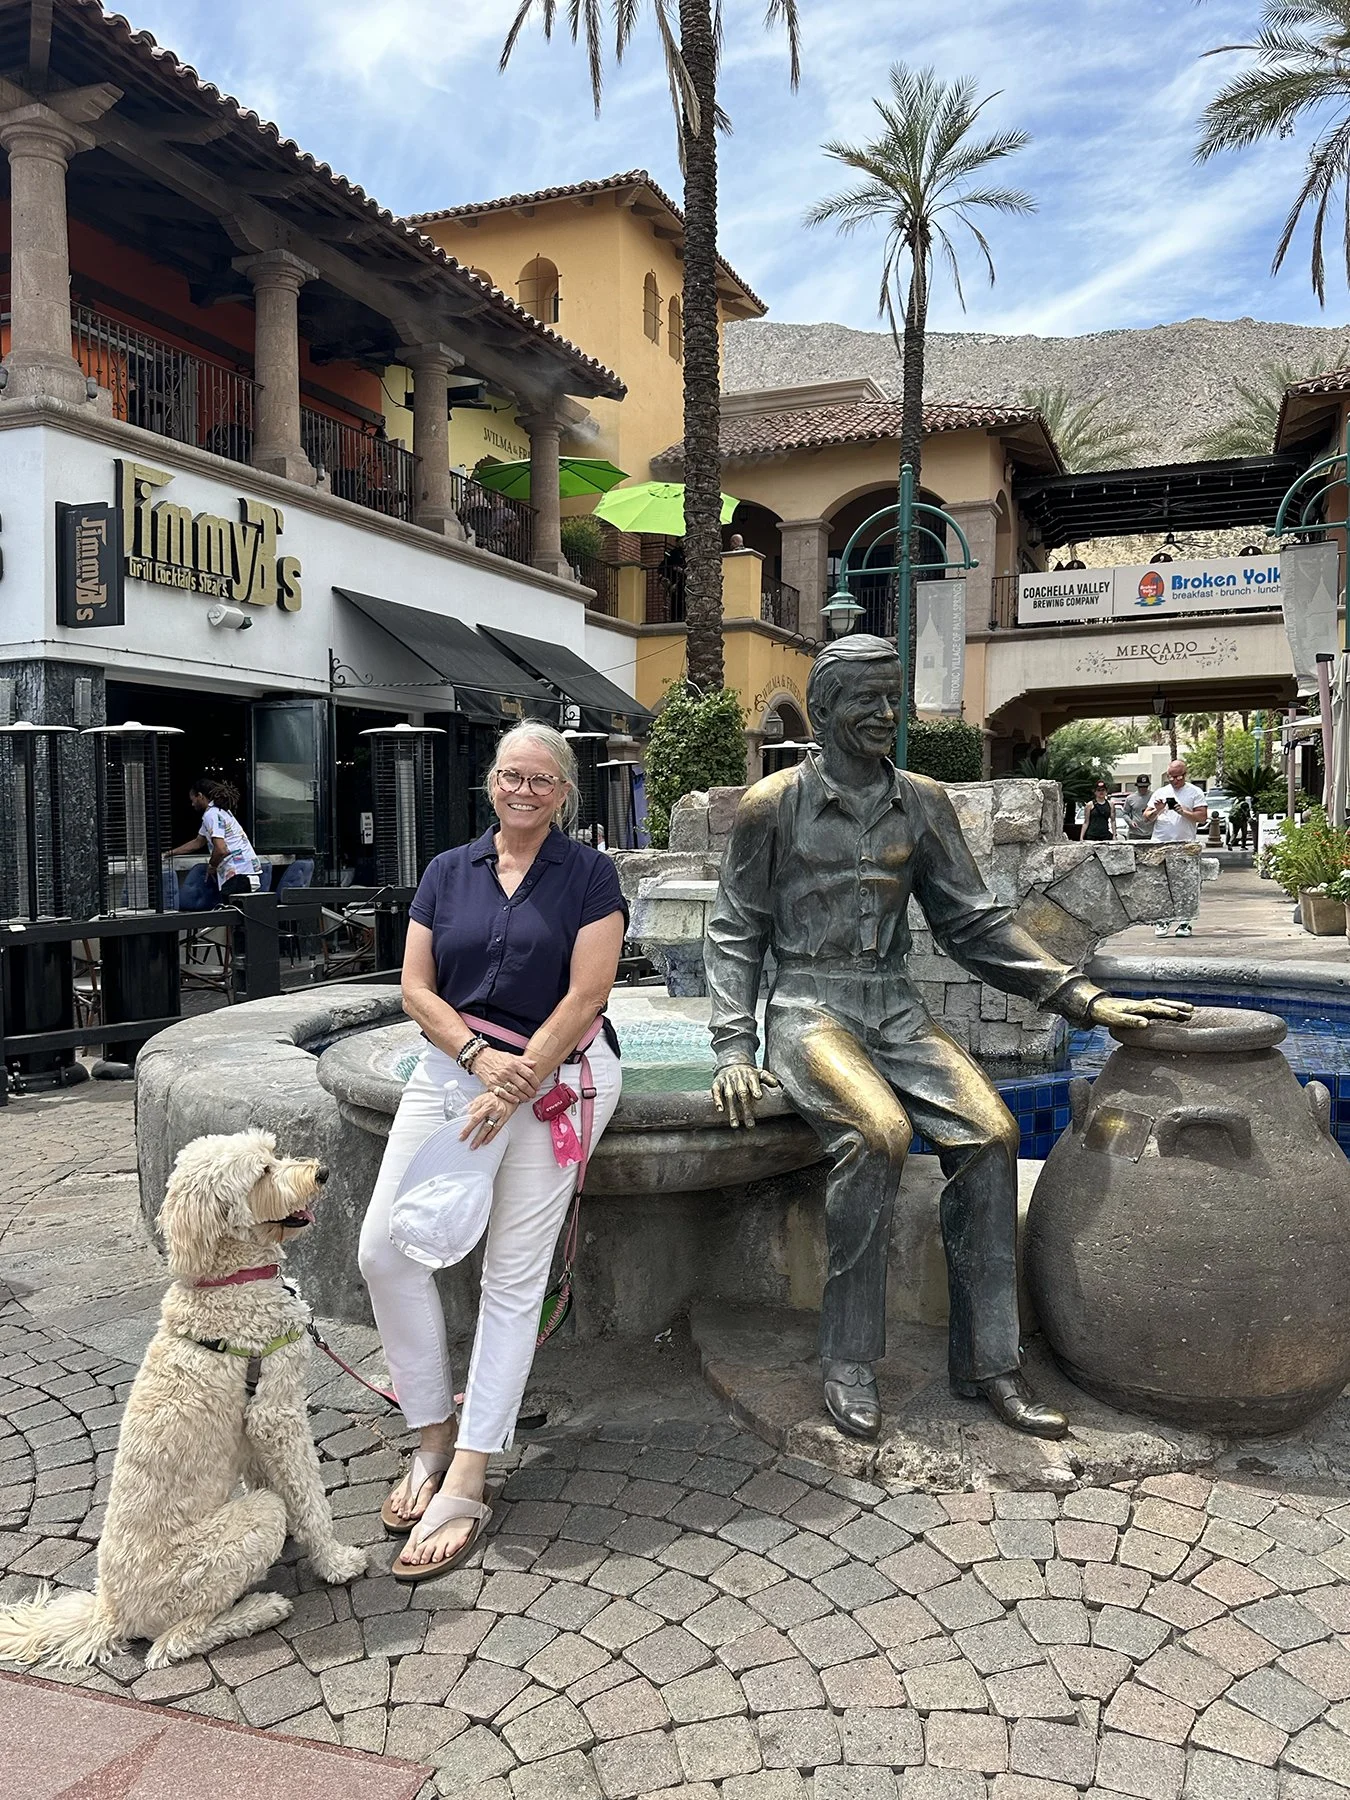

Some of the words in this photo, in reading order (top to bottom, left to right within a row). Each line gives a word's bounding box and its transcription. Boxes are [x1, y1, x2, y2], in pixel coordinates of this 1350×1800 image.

[483, 427, 512, 454] WILMA
[129, 556, 153, 581] Grill
[155, 562, 197, 591] Cocktails
[1171, 572, 1237, 590] Broken
[1243, 567, 1281, 585] Yolk
[953, 582, 962, 611] SPRINGS
[1023, 584, 1075, 599] COACHELLA
[1077, 581, 1110, 595] VALLEY
[1172, 590, 1214, 600] breakfast
[1220, 587, 1251, 597] brunch
[1033, 598, 1064, 609] BREWING
[1066, 596, 1099, 606] COMPANY
[953, 612, 961, 631] PALM
[953, 632, 961, 642] OF
[952, 643, 961, 671] VILLAGE
[1116, 641, 1198, 663] MERCADO
[1159, 653, 1188, 661] PLAZA
[951, 672, 961, 704] HISTORIC
